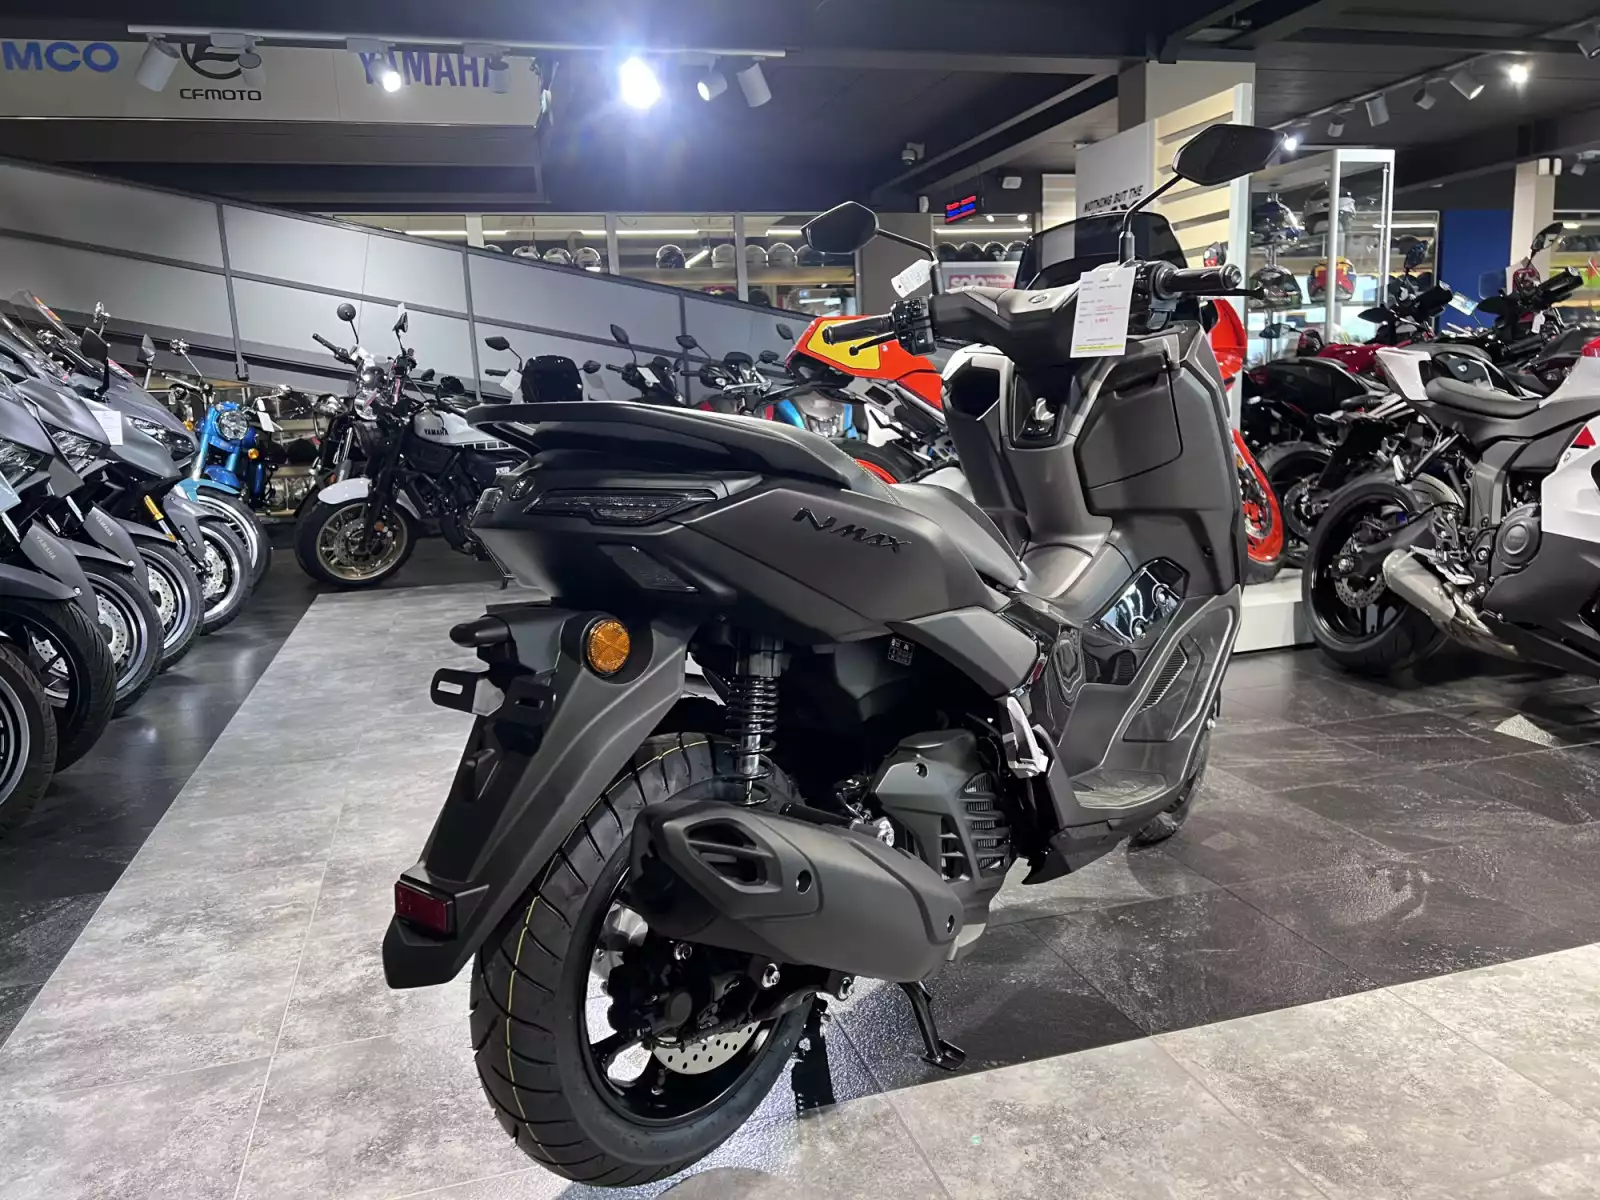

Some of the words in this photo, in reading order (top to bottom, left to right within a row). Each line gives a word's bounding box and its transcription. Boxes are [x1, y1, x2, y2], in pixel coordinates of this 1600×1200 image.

[179, 88, 262, 101] CFMOTO
[1084, 194, 1113, 212] NOTHING
[1113, 190, 1128, 204] BUT
[1129, 185, 1143, 199] THE
[424, 428, 449, 436] YAMAHA
[95, 515, 114, 537] YAMAHA
[36, 536, 56, 560] YAMAHA
